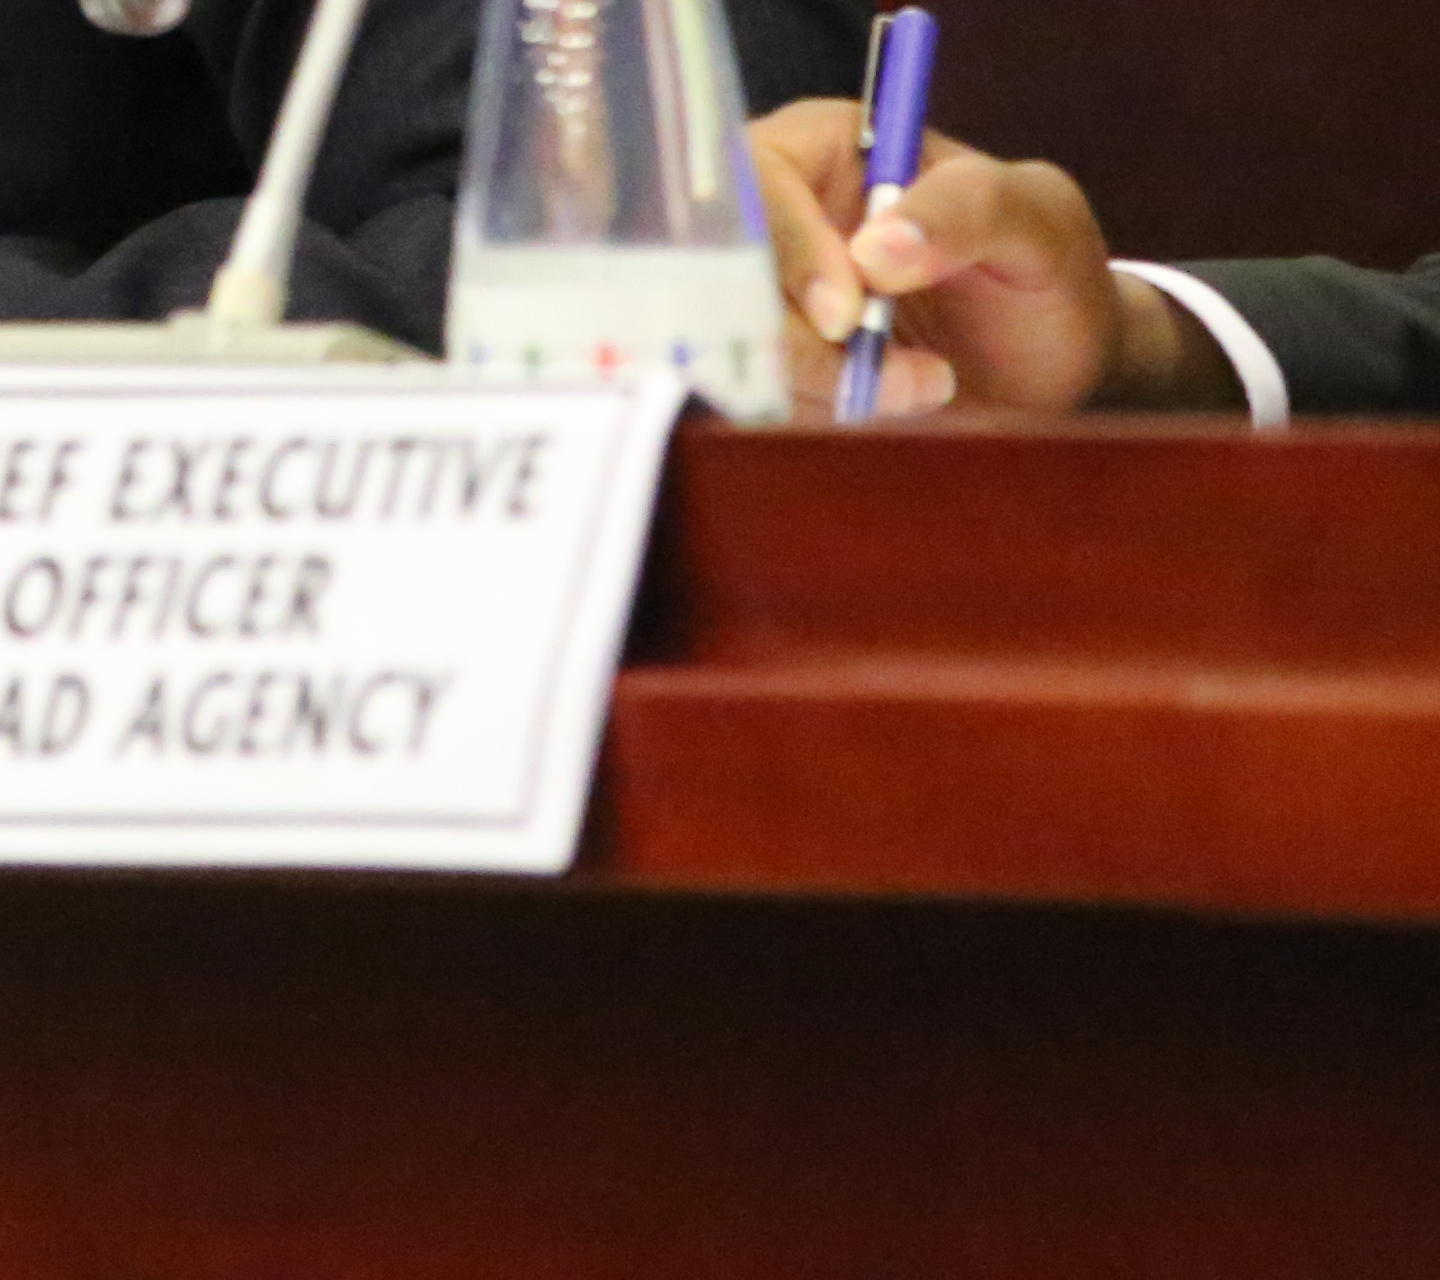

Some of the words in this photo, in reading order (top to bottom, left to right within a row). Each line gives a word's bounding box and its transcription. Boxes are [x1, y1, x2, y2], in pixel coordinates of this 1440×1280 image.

[108, 436, 550, 520] EXECUTIVE
[2, 553, 332, 639] OFFICER
[119, 671, 453, 756] AGENCY
